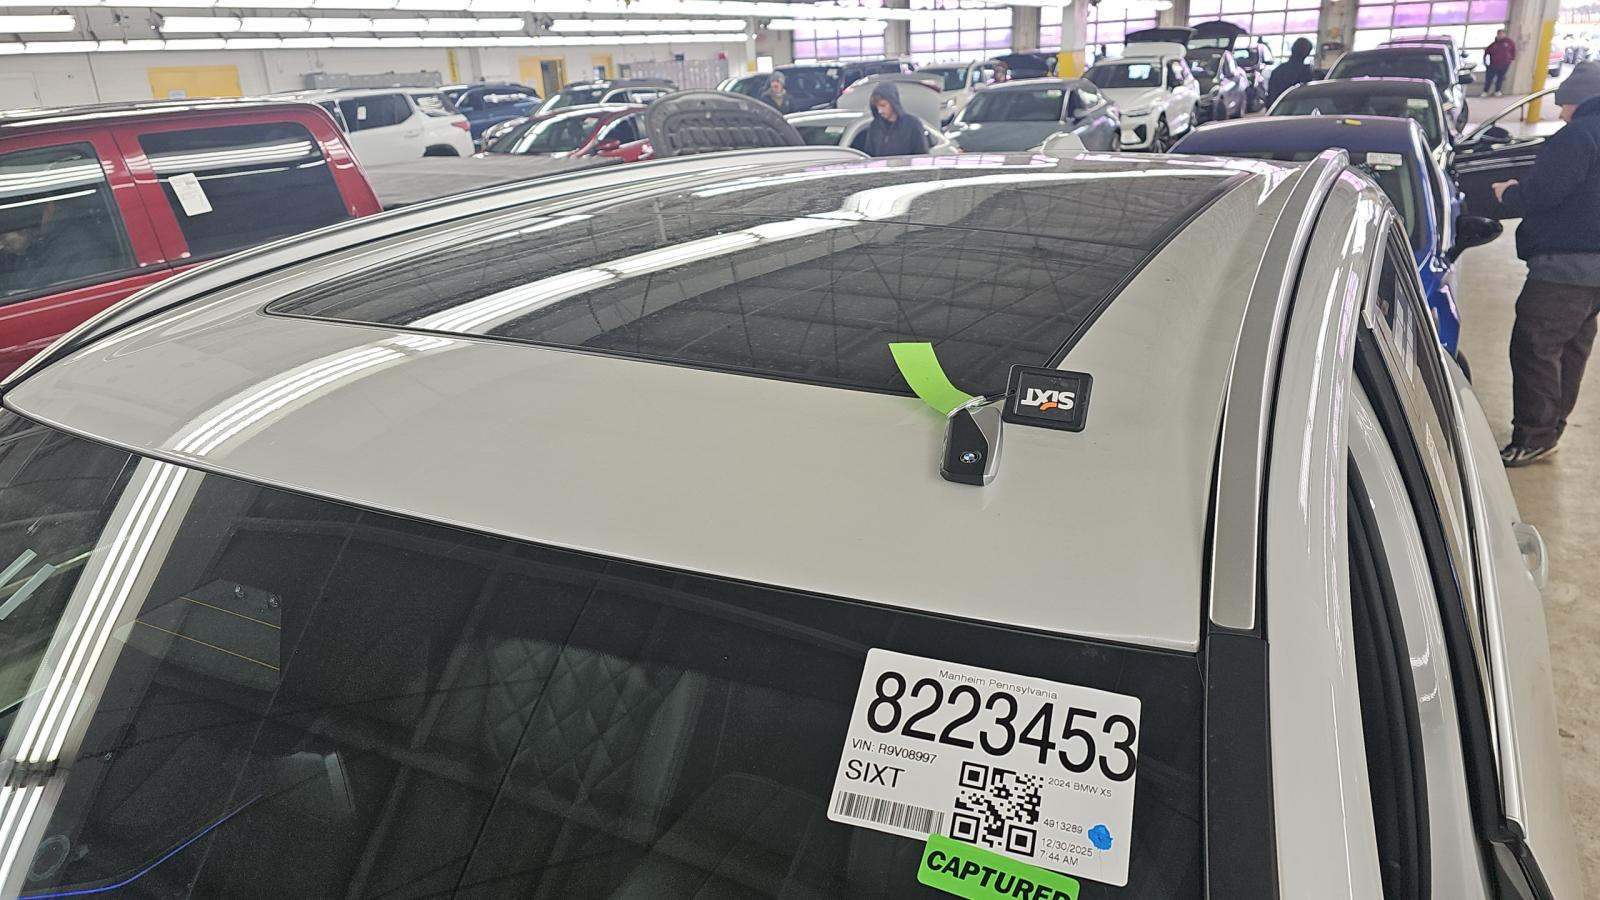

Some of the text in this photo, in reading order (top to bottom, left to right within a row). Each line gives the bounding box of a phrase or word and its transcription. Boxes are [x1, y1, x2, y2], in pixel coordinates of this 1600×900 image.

[1020, 387, 1076, 411] SIXT
[938, 670, 1058, 700] Manheim Pennsylvania
[867, 671, 1137, 781] 8223453
[852, 738, 938, 764] VIN: R9V08997
[845, 759, 906, 788] SIXT
[1048, 777, 1112, 798] 2024 BMW X5
[1043, 818, 1083, 834] 4913289
[1040, 849, 1079, 867] 7:44 AM
[1042, 838, 1093, 857] 12/30/2025
